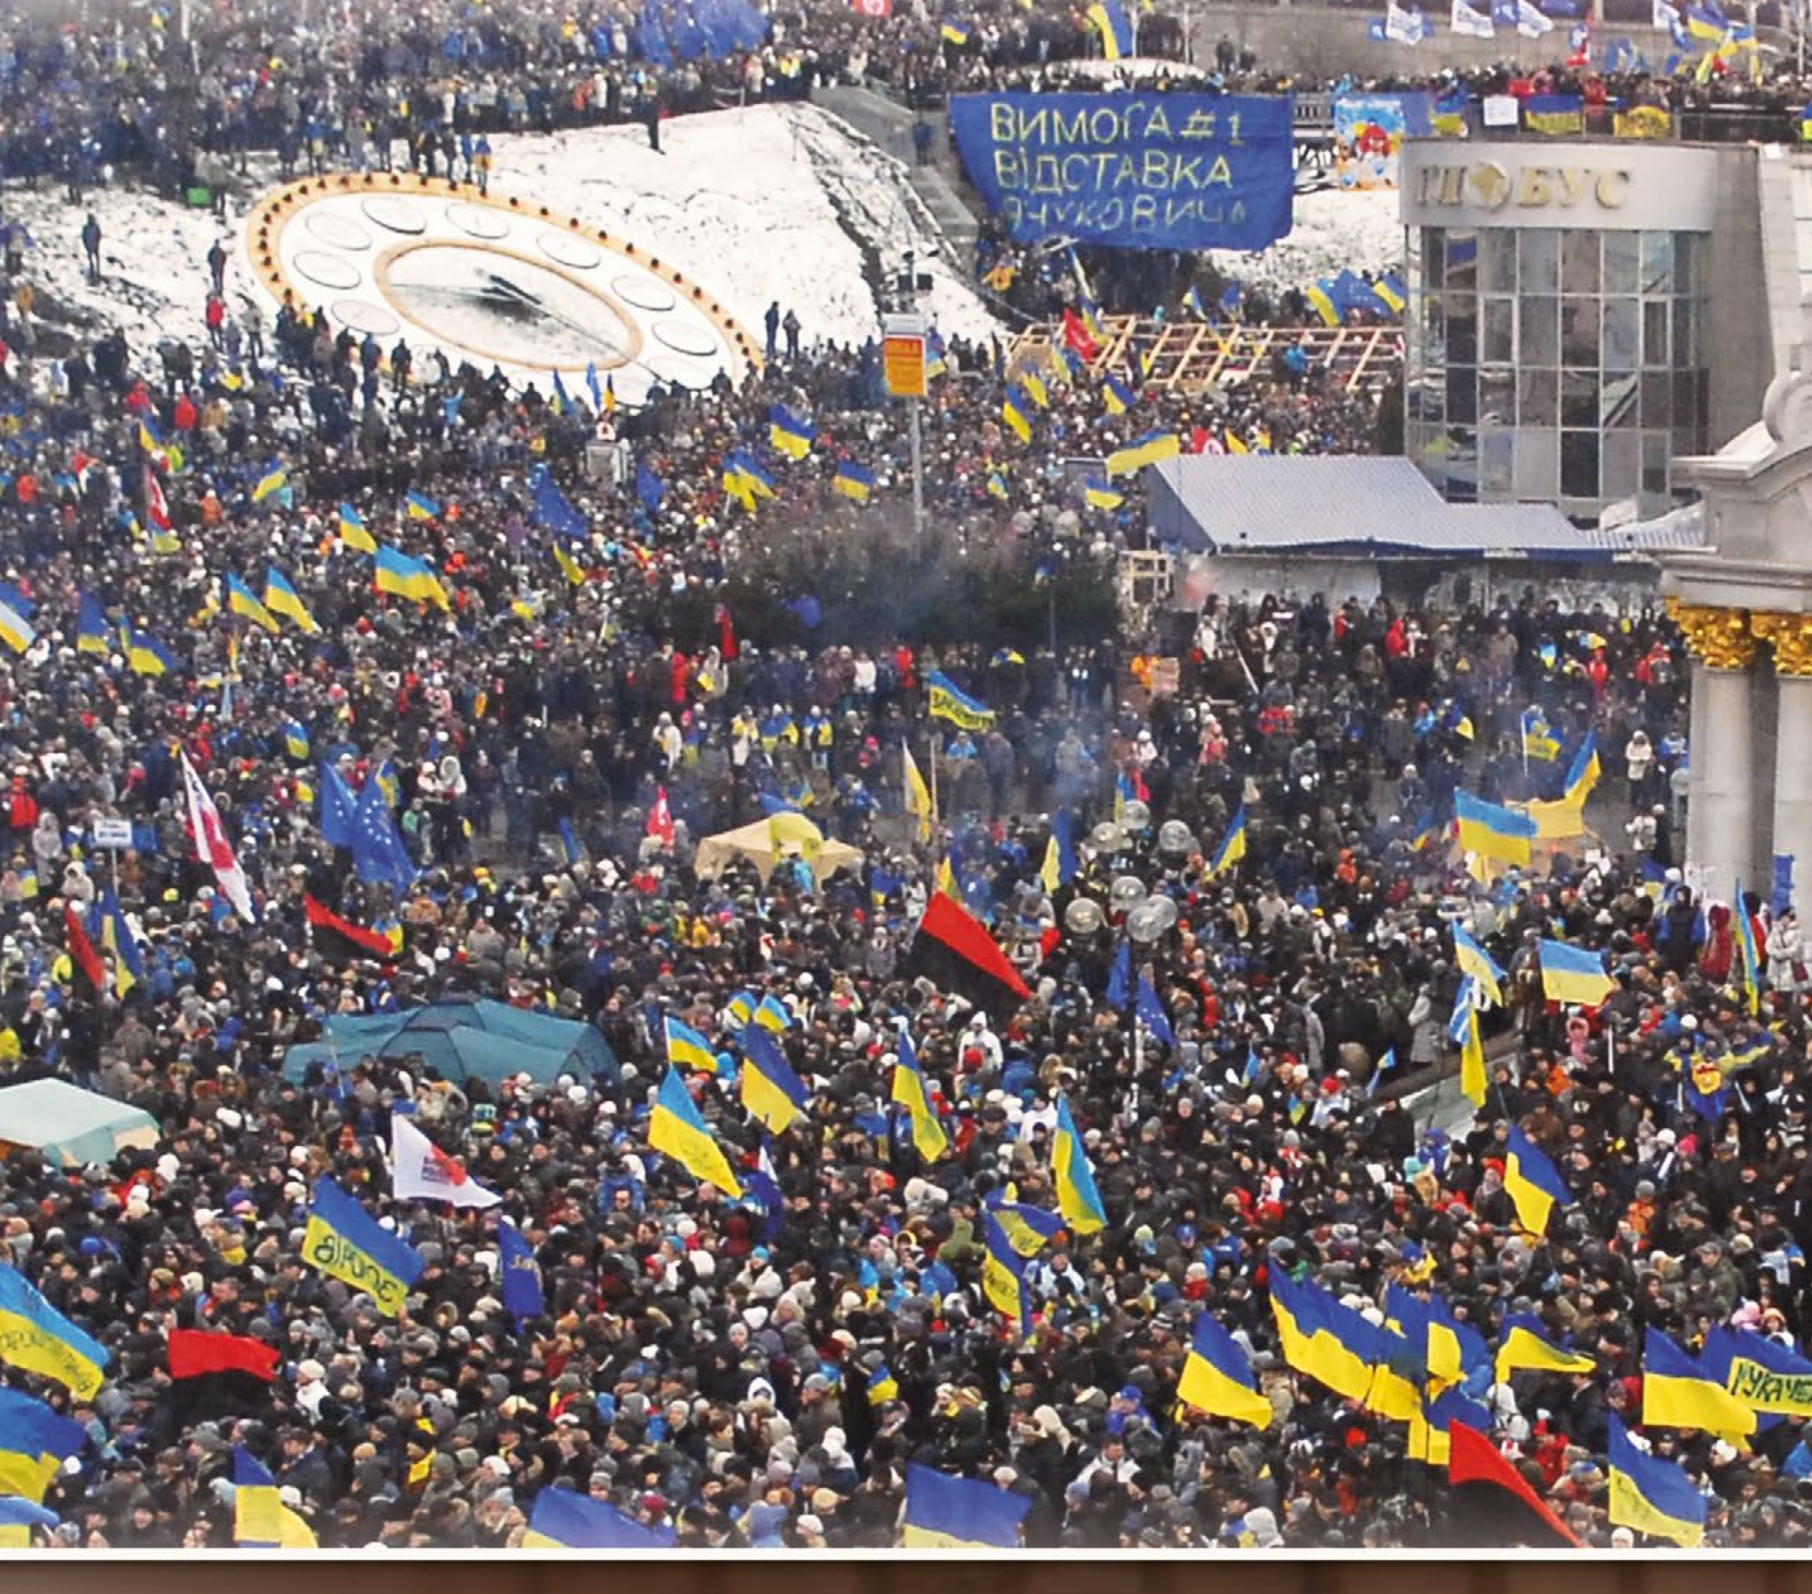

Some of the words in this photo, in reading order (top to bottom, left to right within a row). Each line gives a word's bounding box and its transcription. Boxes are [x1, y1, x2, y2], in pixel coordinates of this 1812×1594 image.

[990, 102, 1173, 145] ВИМОГА
[993, 148, 1233, 195] ВІДСТАВКА
[1416, 160, 1631, 213] ГЛОБУС
